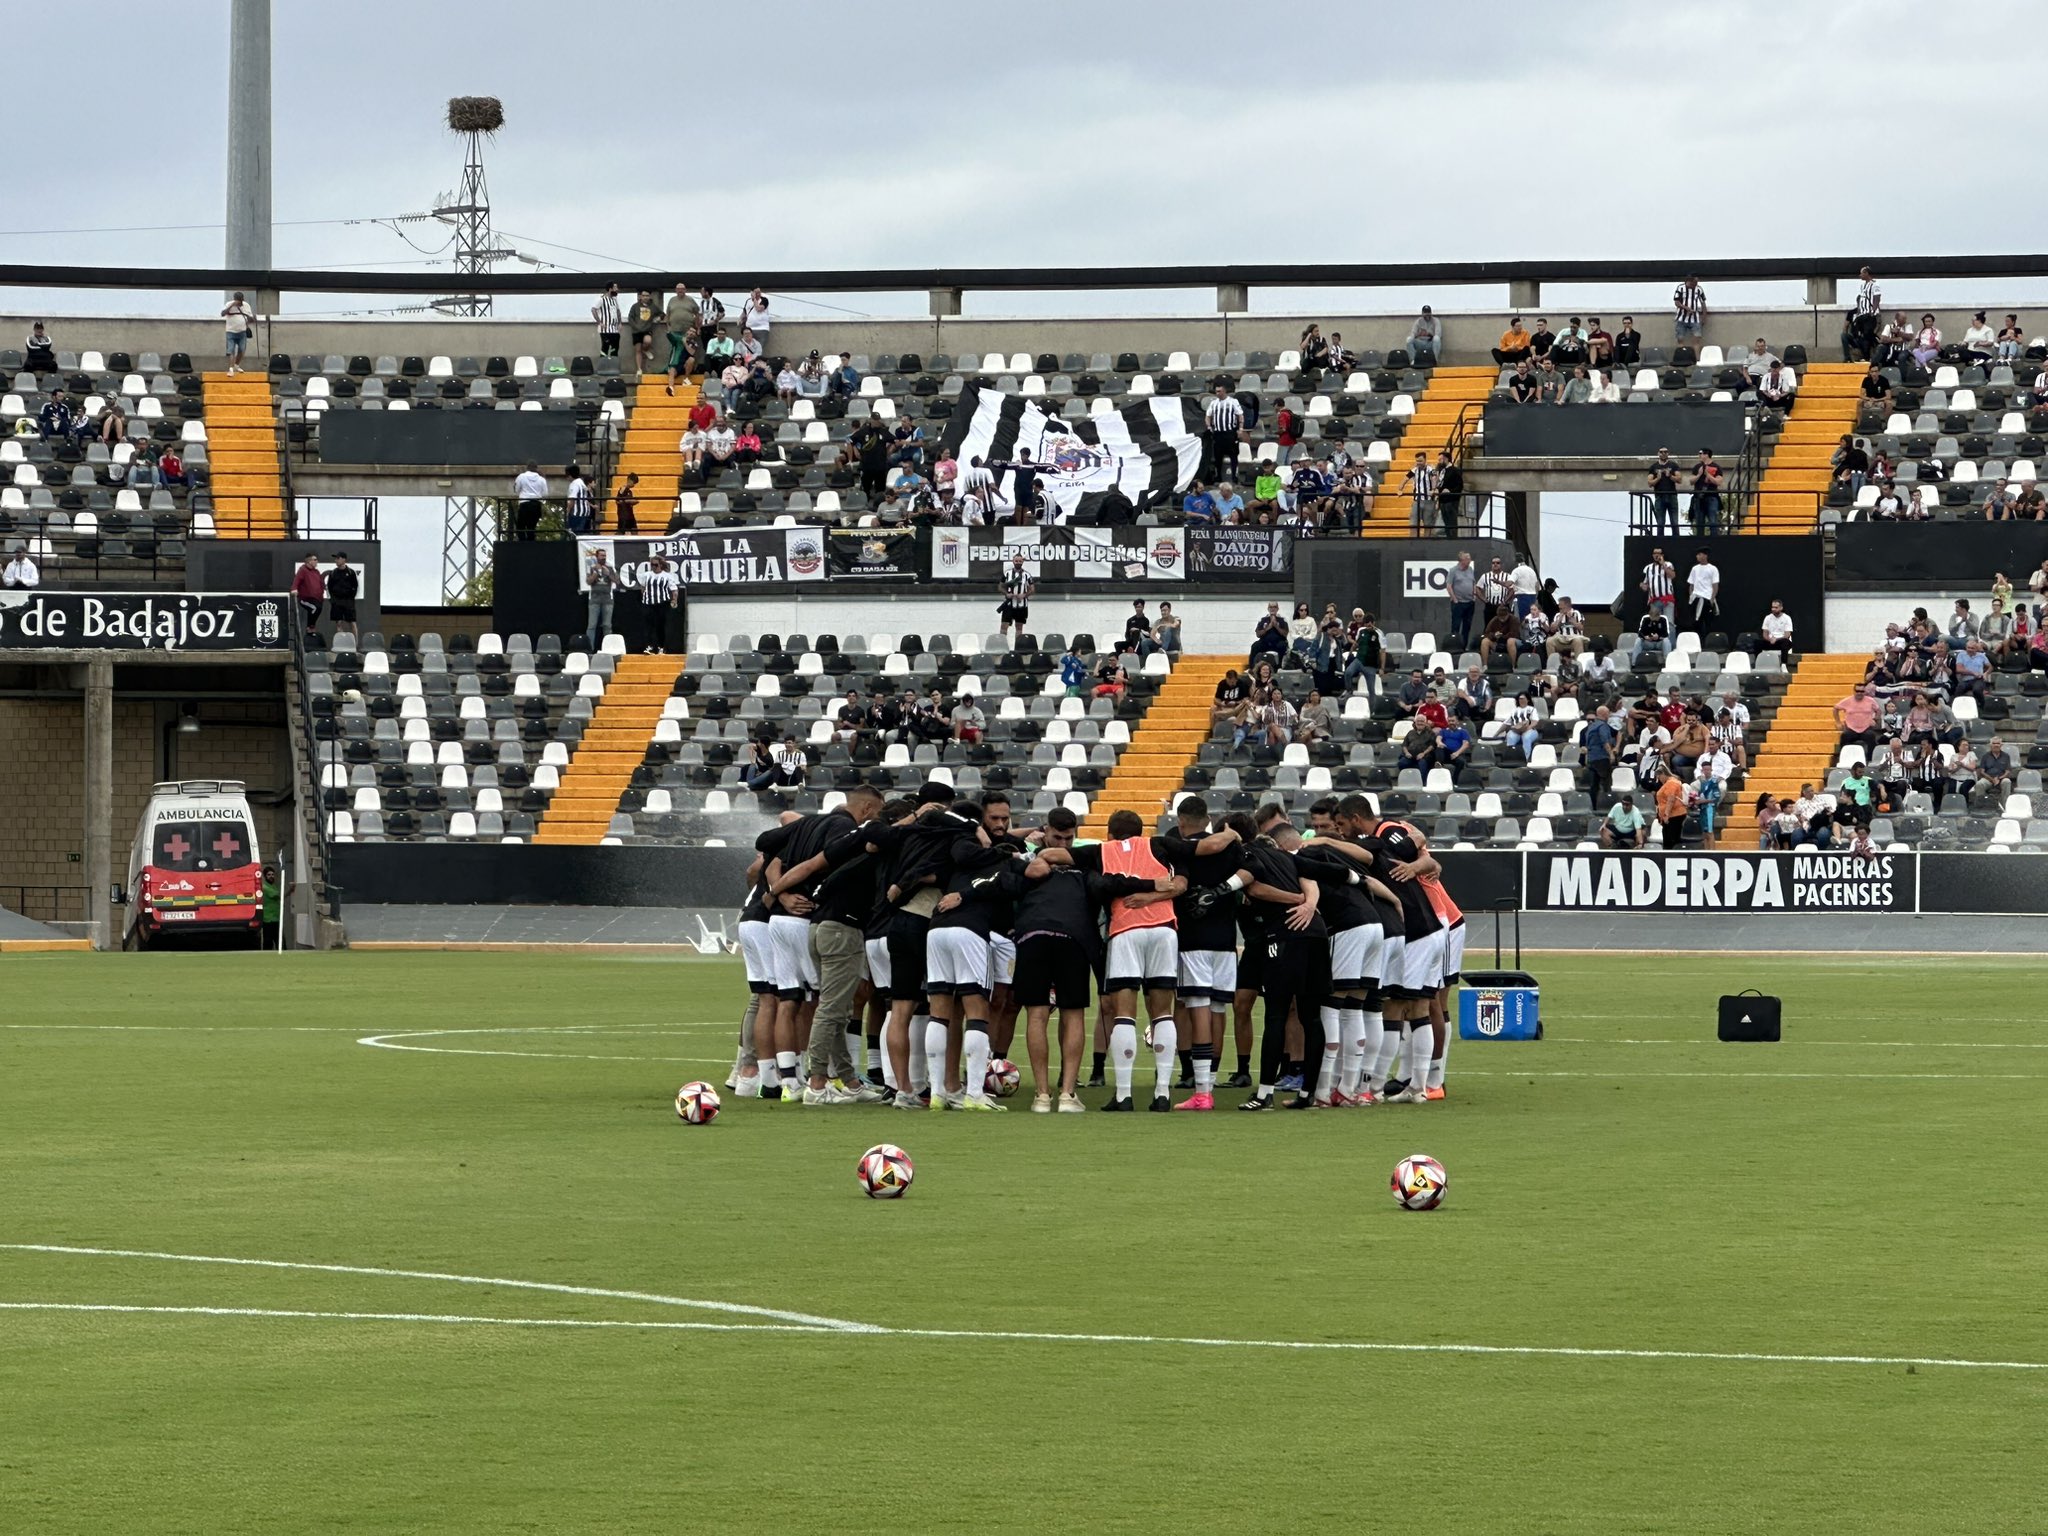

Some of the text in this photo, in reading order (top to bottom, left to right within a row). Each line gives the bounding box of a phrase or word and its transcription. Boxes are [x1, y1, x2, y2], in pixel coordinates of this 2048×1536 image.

[648, 538, 752, 558] PEÑA LA
[969, 543, 1147, 562] FEDERACIÓN DE PEÑAS
[1214, 542, 1269, 554] DAVID
[20, 598, 67, 637] de
[83, 598, 236, 646] Badajoz
[156, 809, 245, 821] AMBULANCIA
[1793, 856, 1894, 879] MADERAS
[1547, 857, 1785, 907] MADERPA
[1793, 882, 1894, 906] PACENSES
